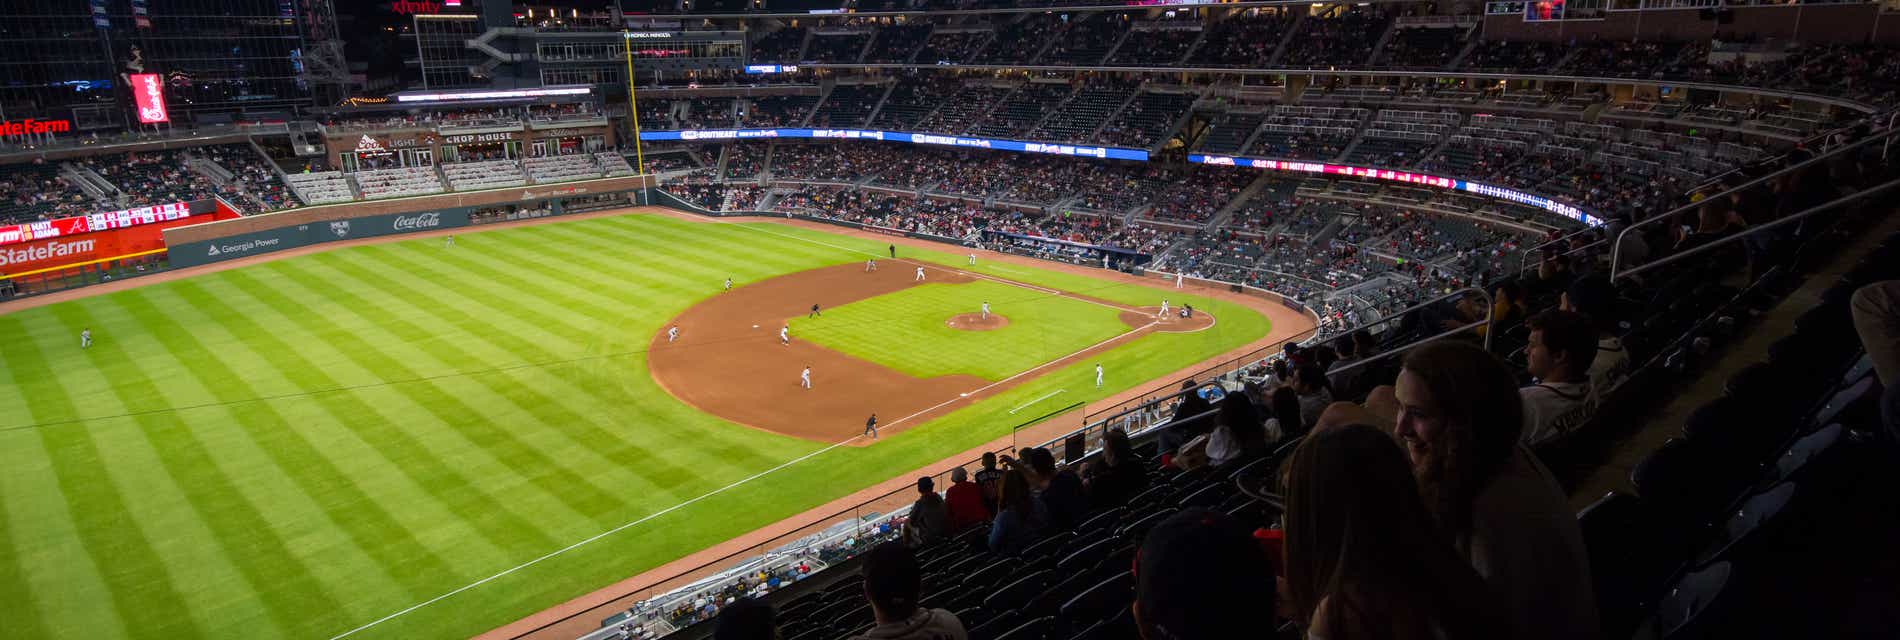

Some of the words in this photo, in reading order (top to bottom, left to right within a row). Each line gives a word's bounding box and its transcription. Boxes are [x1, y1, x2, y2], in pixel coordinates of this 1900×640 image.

[392, 0, 440, 15] xfinity
[389, 139, 416, 148] LIGHT
[446, 135, 474, 144] CHOP
[478, 132, 512, 141] HOUSE
[1289, 162, 1304, 171] MATT
[1304, 163, 1324, 172] ADAMS
[32, 221, 51, 230] MATT
[34, 227, 60, 239] ADAMS
[222, 241, 254, 253] Georgia
[255, 238, 279, 248] Power
[0, 240, 94, 266] StateFarm
